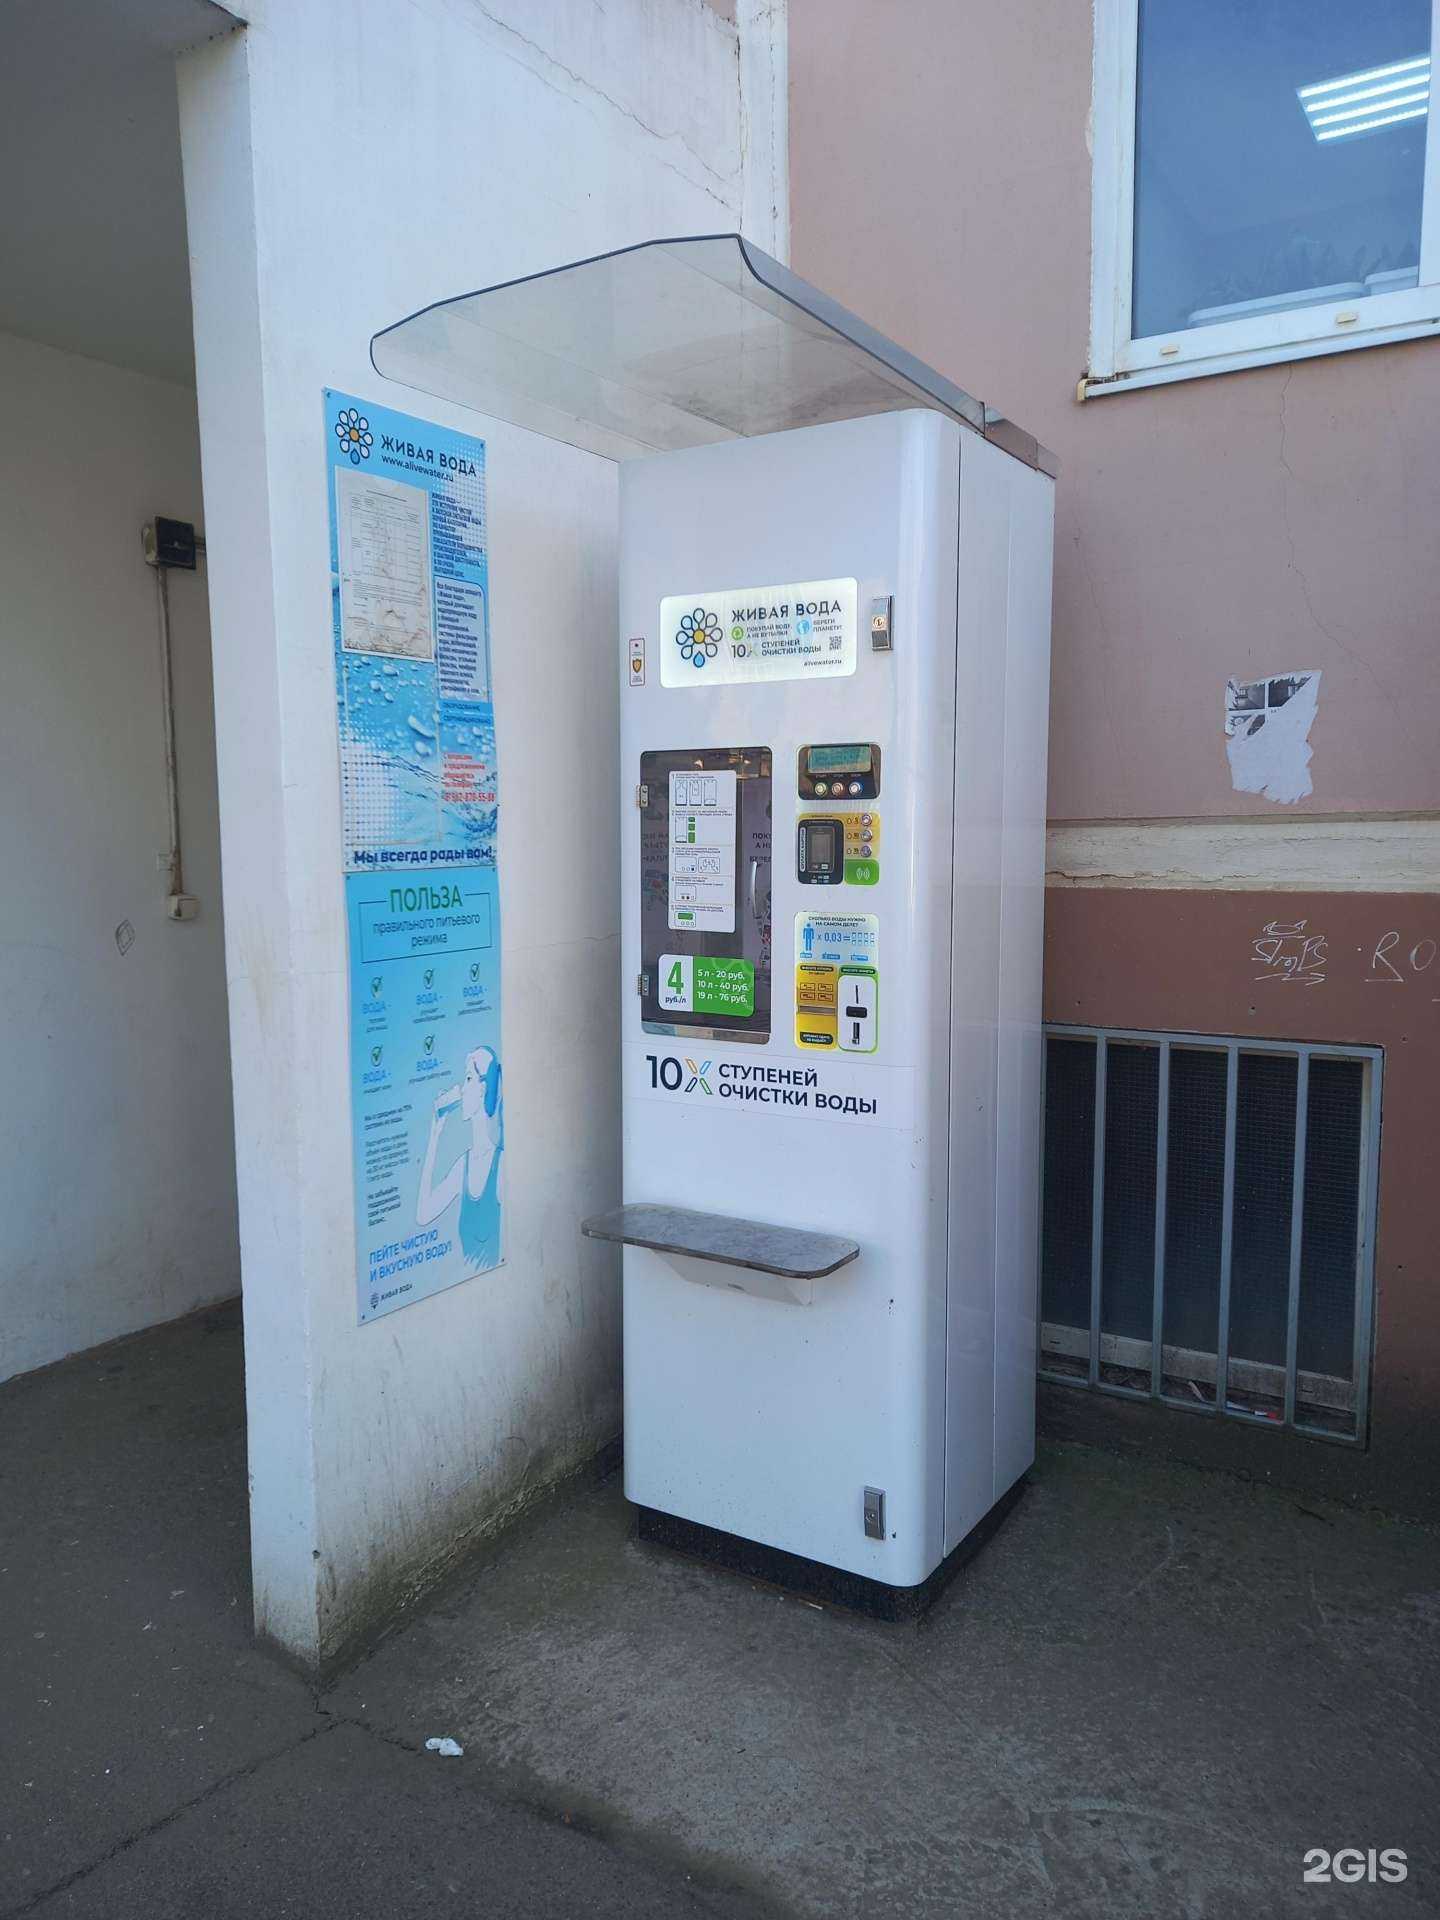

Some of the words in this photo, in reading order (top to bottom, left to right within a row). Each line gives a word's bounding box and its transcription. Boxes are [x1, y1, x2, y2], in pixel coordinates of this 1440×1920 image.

[380, 434, 434, 464] ЖИВАЯ
[440, 452, 477, 477] ВОДА
[381, 454, 454, 482] www.alivewater.ru
[731, 605, 789, 622] ЖИВАЯ
[795, 600, 842, 616] ВОДА
[761, 638, 800, 648] СТУПЕНЕЙ
[761, 647, 796, 656] ОЧИСТКИ
[797, 645, 822, 655] ВОДЫ
[354, 850, 379, 865] Мы
[381, 850, 427, 863] всегда
[430, 849, 464, 864] рады
[466, 846, 493, 860] вам!
[389, 885, 463, 913] ПОЛЬЗА
[373, 917, 435, 935] правильного
[436, 912, 481, 930] питьевого
[410, 932, 449, 949] режима
[824, 931, 842, 943] 0,03
[667, 961, 684, 994] 4
[716, 970, 726, 978] 20
[463, 985, 484, 998] ВОДА
[697, 980, 705, 988] 10
[415, 993, 439, 1006] ВОДА
[664, 995, 687, 1004] руб./л
[361, 1002, 387, 1015] ВОДА
[415, 1059, 439, 1072] ВОДА
[362, 1070, 387, 1084] ВОДА
[718, 1063, 818, 1087] СТУПЕНЕЙ
[718, 1083, 809, 1107] ОЧИСТКИ
[815, 1093, 878, 1115] ВОДЫ
[369, 1244, 400, 1265] ПЕЙТЕ
[401, 1229, 439, 1251] ЧИСТУЮ
[370, 1269, 378, 1282] И
[379, 1253, 424, 1279] ВКУСНУЮ
[425, 1240, 453, 1262] ВОДУ!
